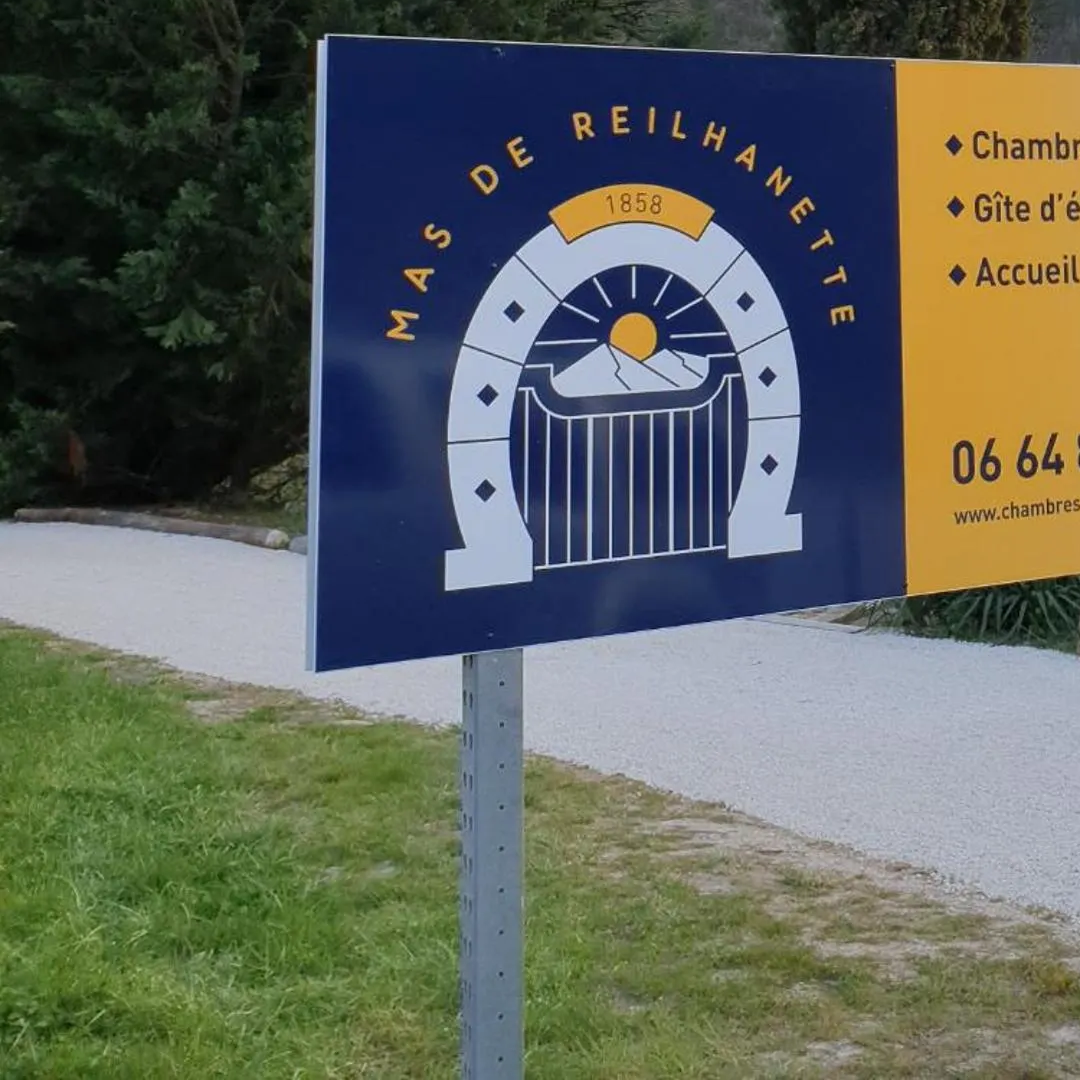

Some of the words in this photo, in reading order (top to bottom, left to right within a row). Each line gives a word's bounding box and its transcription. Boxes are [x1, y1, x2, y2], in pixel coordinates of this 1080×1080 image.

[606, 192, 662, 215] 1858
[974, 191, 1031, 222] Gîte
[386, 222, 452, 342] MAS
[470, 136, 534, 195] DE
[572, 106, 856, 327] REILHANETTE
[975, 254, 1080, 287] Accueil
[952, 438, 1002, 485] 06
[1016, 432, 1065, 479] 64
